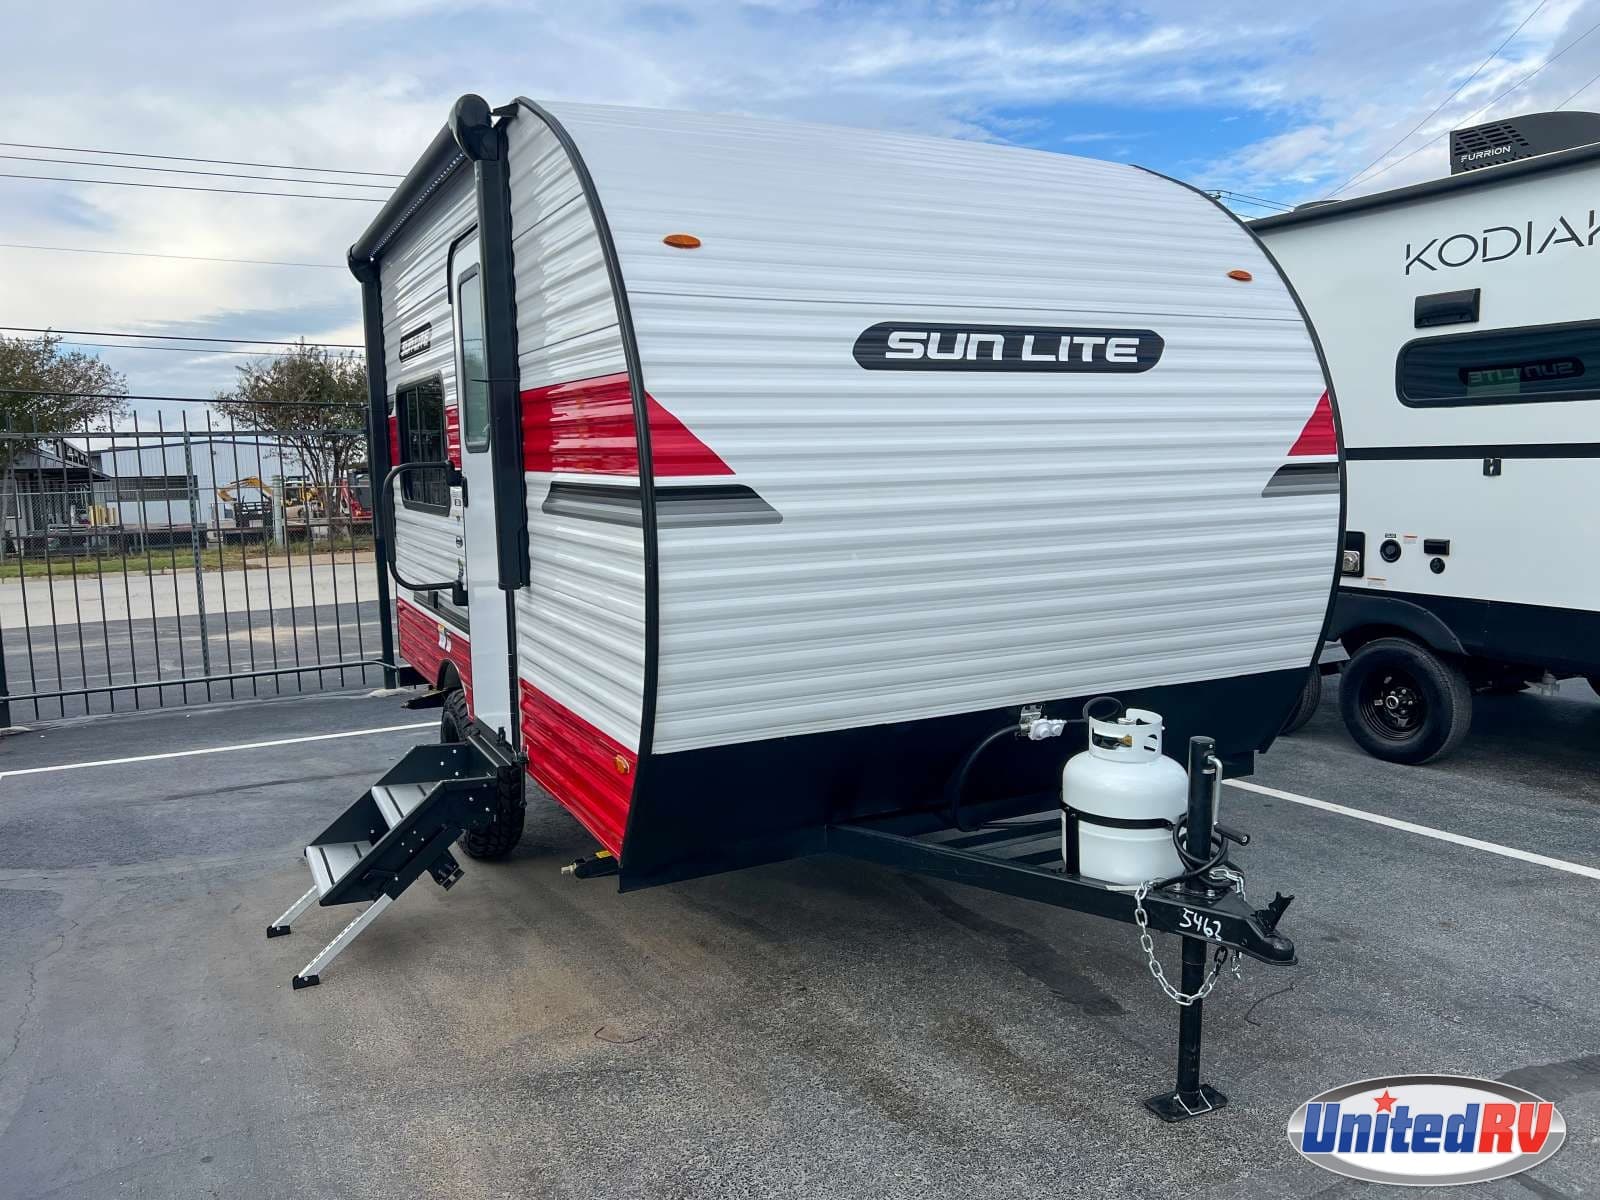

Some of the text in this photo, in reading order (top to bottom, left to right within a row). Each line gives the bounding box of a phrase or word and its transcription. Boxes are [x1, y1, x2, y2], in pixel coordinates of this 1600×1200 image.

[1461, 145, 1511, 162] FURRION
[885, 331, 1140, 363] SUN LITE
[1180, 908, 1222, 941] 5462
